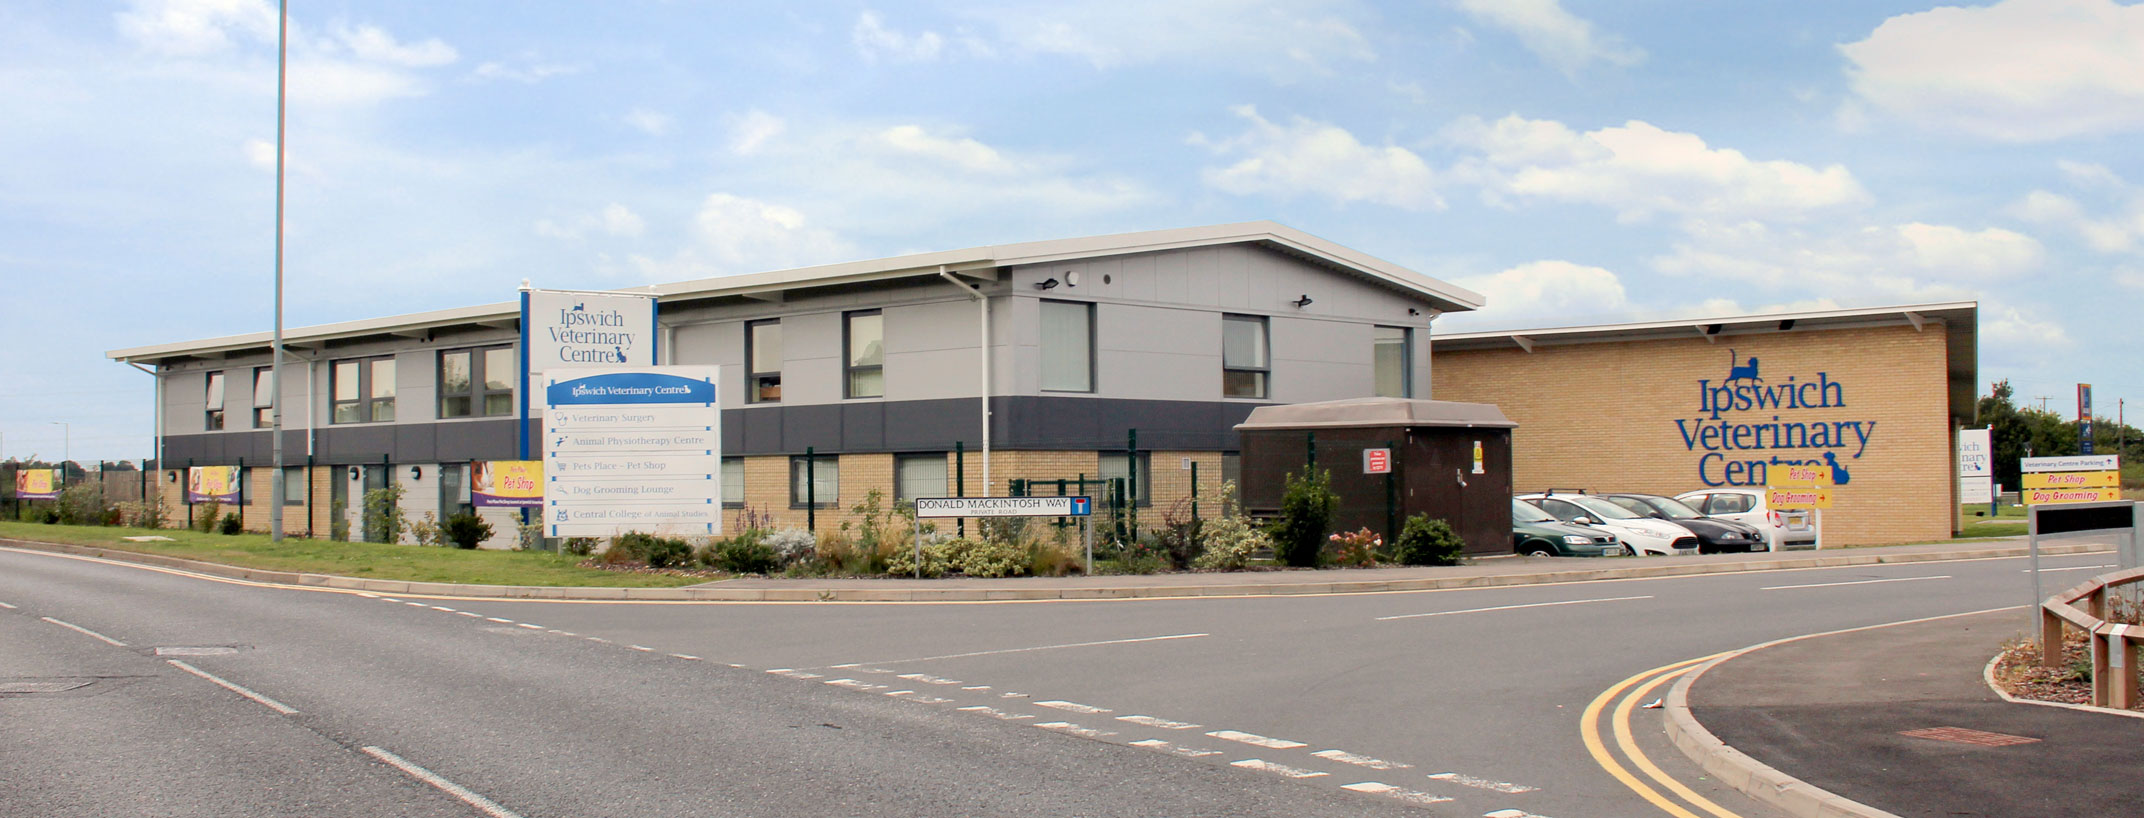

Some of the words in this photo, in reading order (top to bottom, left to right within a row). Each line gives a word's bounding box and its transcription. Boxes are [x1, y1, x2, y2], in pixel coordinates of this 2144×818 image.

[560, 308, 624, 328] Ipswich
[549, 326, 636, 350] Veterinary
[560, 345, 615, 363] Centre
[572, 387, 606, 397] Ipswich
[607, 386, 654, 396] Veterinary
[655, 385, 685, 395] Centre
[1698, 372, 1846, 420] Ipswich
[573, 414, 618, 423] Veterinary
[622, 413, 655, 423] Surgery
[573, 437, 605, 446] Animal
[607, 436, 671, 446] Physiotherapy
[673, 435, 704, 444] Centre
[1674, 415, 1877, 458] Veterinary
[573, 462, 592, 471] Pets
[594, 461, 617, 470] Place
[627, 461, 641, 470] Pet
[643, 460, 666, 470] Shop
[1698, 452, 1823, 486] Cen
[2080, 459, 2104, 467] Parking
[1789, 467, 1800, 480] Pet
[2047, 474, 2062, 484] Pet
[2064, 474, 2086, 485] Shop
[503, 475, 515, 489] Pet
[516, 476, 535, 493] Shop
[573, 486, 592, 495] Dog
[594, 485, 639, 495] Grooming
[641, 485, 674, 495] Lounge
[2032, 491, 2051, 503] Dog
[2052, 490, 2099, 502] Grooming
[919, 500, 964, 509] DONALD
[967, 499, 1041, 509] MACKINTOSH
[1046, 498, 1068, 508] WAY
[573, 510, 607, 519] Central
[608, 509, 642, 520] College
[654, 510, 680, 518] Animal
[681, 509, 708, 517] Studies
